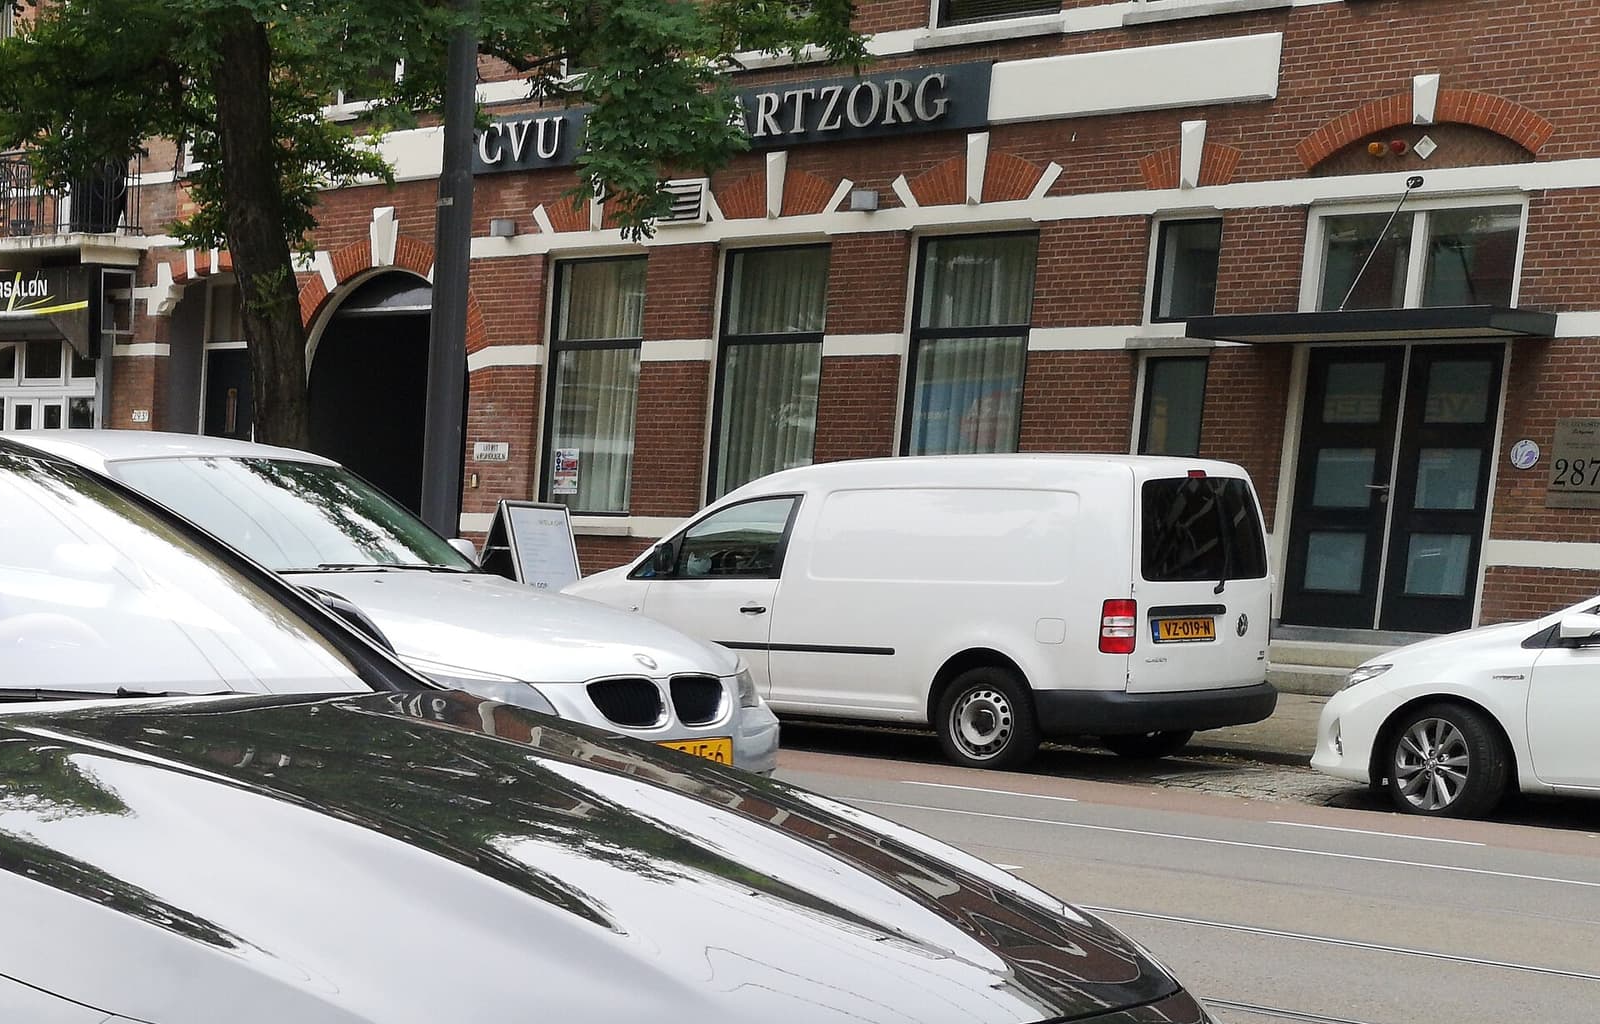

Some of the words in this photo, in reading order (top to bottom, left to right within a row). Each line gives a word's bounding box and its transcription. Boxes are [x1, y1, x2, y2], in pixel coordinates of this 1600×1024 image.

[478, 115, 565, 165] CVU
[1552, 457, 1600, 486] 287
[1164, 620, 1211, 636] VZ-019-N
